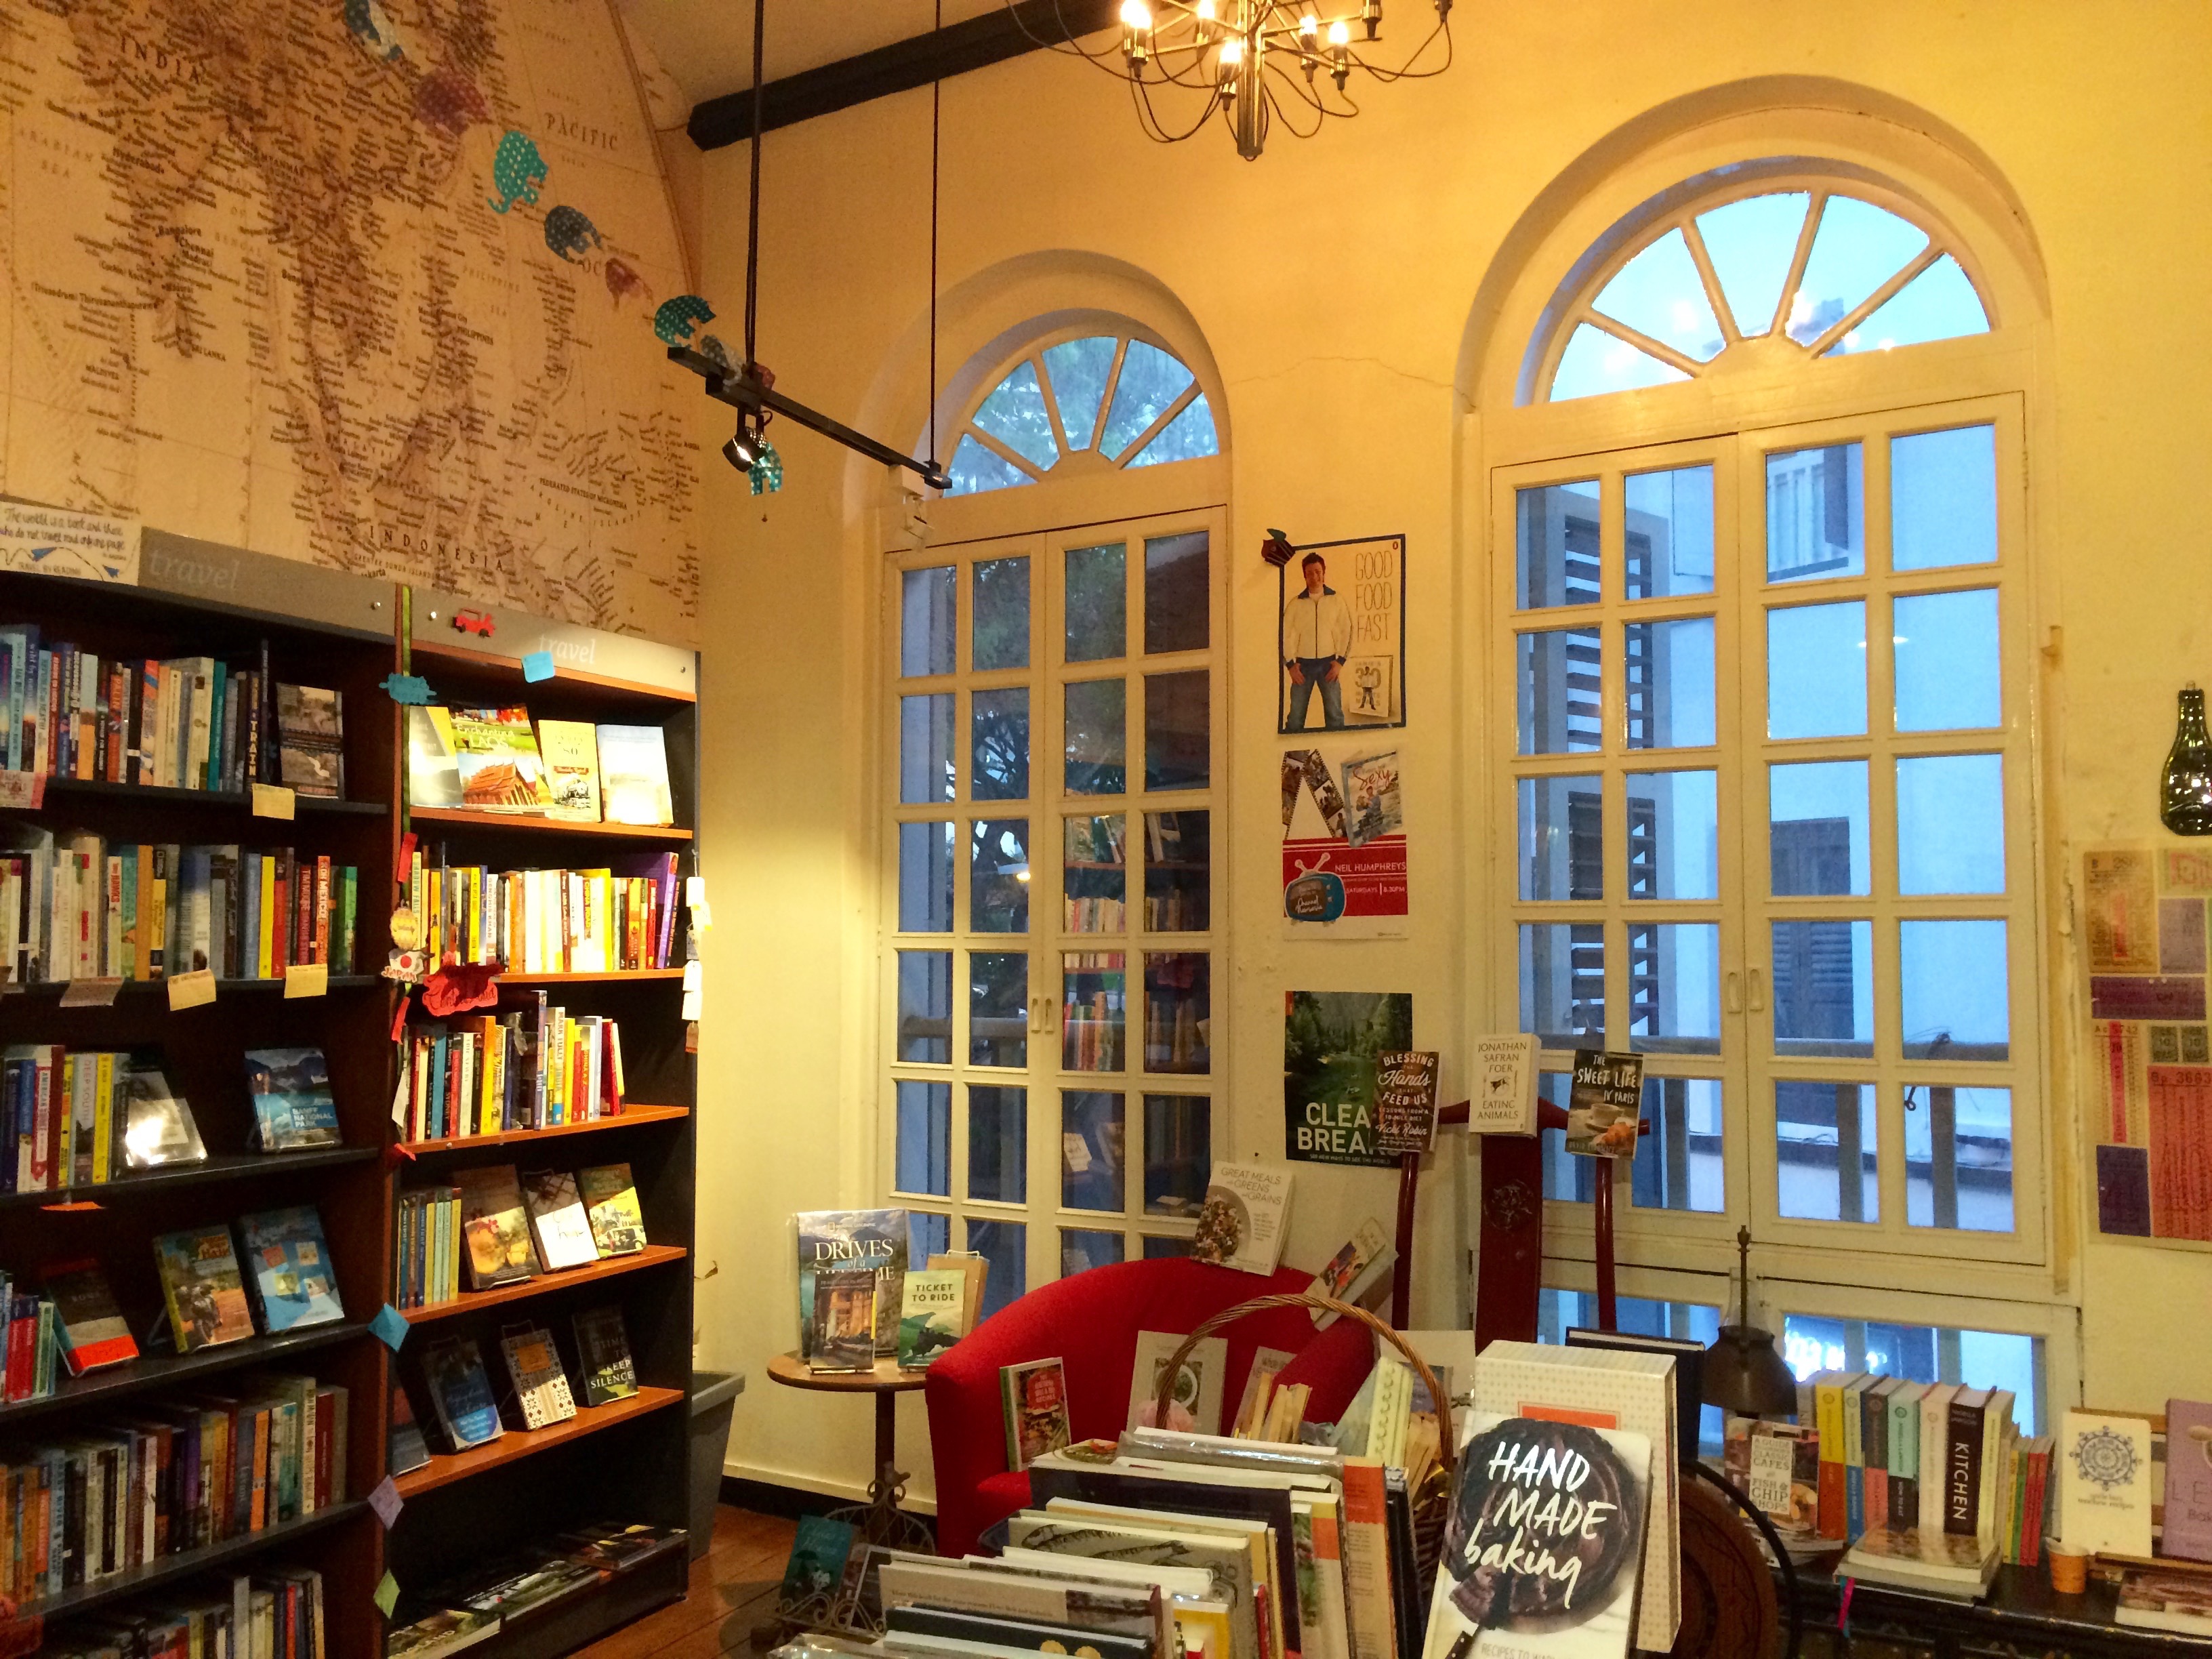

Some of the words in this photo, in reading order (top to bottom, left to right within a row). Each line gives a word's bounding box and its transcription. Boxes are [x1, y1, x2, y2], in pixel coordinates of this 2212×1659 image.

[121, 35, 203, 85] INDIA
[544, 112, 619, 150] PACIFIC
[369, 525, 504, 573] INDONESIA
[148, 550, 241, 590] travel
[1355, 550, 1393, 581] GOOD
[1355, 581, 1393, 611] FOOD
[1357, 612, 1392, 643] FAST
[539, 634, 596, 665] travel
[112, 678, 122, 710] PALIN
[455, 722, 516, 743] Enchanting
[249, 720, 259, 776] TRAIN
[469, 735, 509, 748] LAOS
[1353, 766, 1392, 791] Sexy
[1335, 864, 1352, 873] NEIL
[1354, 862, 1406, 872] HUMPHREYS
[1477, 1042, 1528, 1053] JONATHAN
[1383, 1052, 1435, 1067] BLESSING
[1483, 1053, 1519, 1063] SAFRAN
[1593, 1054, 1606, 1067] THE
[1489, 1064, 1513, 1073] FOER
[1377, 1069, 1432, 1087] Hands
[1576, 1067, 1611, 1086] SWEET
[1614, 1071, 1637, 1088] LIFE
[1382, 1091, 1410, 1106] FEED
[1413, 1092, 1428, 1105] US
[1482, 1100, 1516, 1109] EATING
[1614, 1090, 1635, 1105] PARIS
[293, 1112, 334, 1122] NATIONAL
[1305, 1102, 1371, 1128] CLEA
[1477, 1110, 1519, 1120] ANIMALS
[294, 1120, 318, 1128] PARK
[1402, 1122, 1429, 1137] Robin
[1221, 1166, 1250, 1179] GREAT
[1251, 1171, 1282, 1185] MEALS
[1233, 1179, 1270, 1193] GREENS
[1248, 1193, 1282, 1206] GRAINS
[815, 1238, 894, 1261] DRIVES
[847, 1256, 859, 1271] of
[859, 1259, 866, 1269] a
[916, 1283, 953, 1292] TICKET
[912, 1294, 926, 1302] TO
[930, 1293, 955, 1302] RIDE
[590, 1370, 634, 1389] SILENCE
[1762, 1438, 1790, 1448] GUIDE
[1488, 1441, 1590, 1492] HAND
[1752, 1477, 1777, 1490] FISH
[1952, 1441, 1970, 1520] KITCHEN
[1751, 1487, 1788, 1502] CHIP
[1493, 1488, 1618, 1539] MADE
[1464, 1518, 1582, 1610] baking
